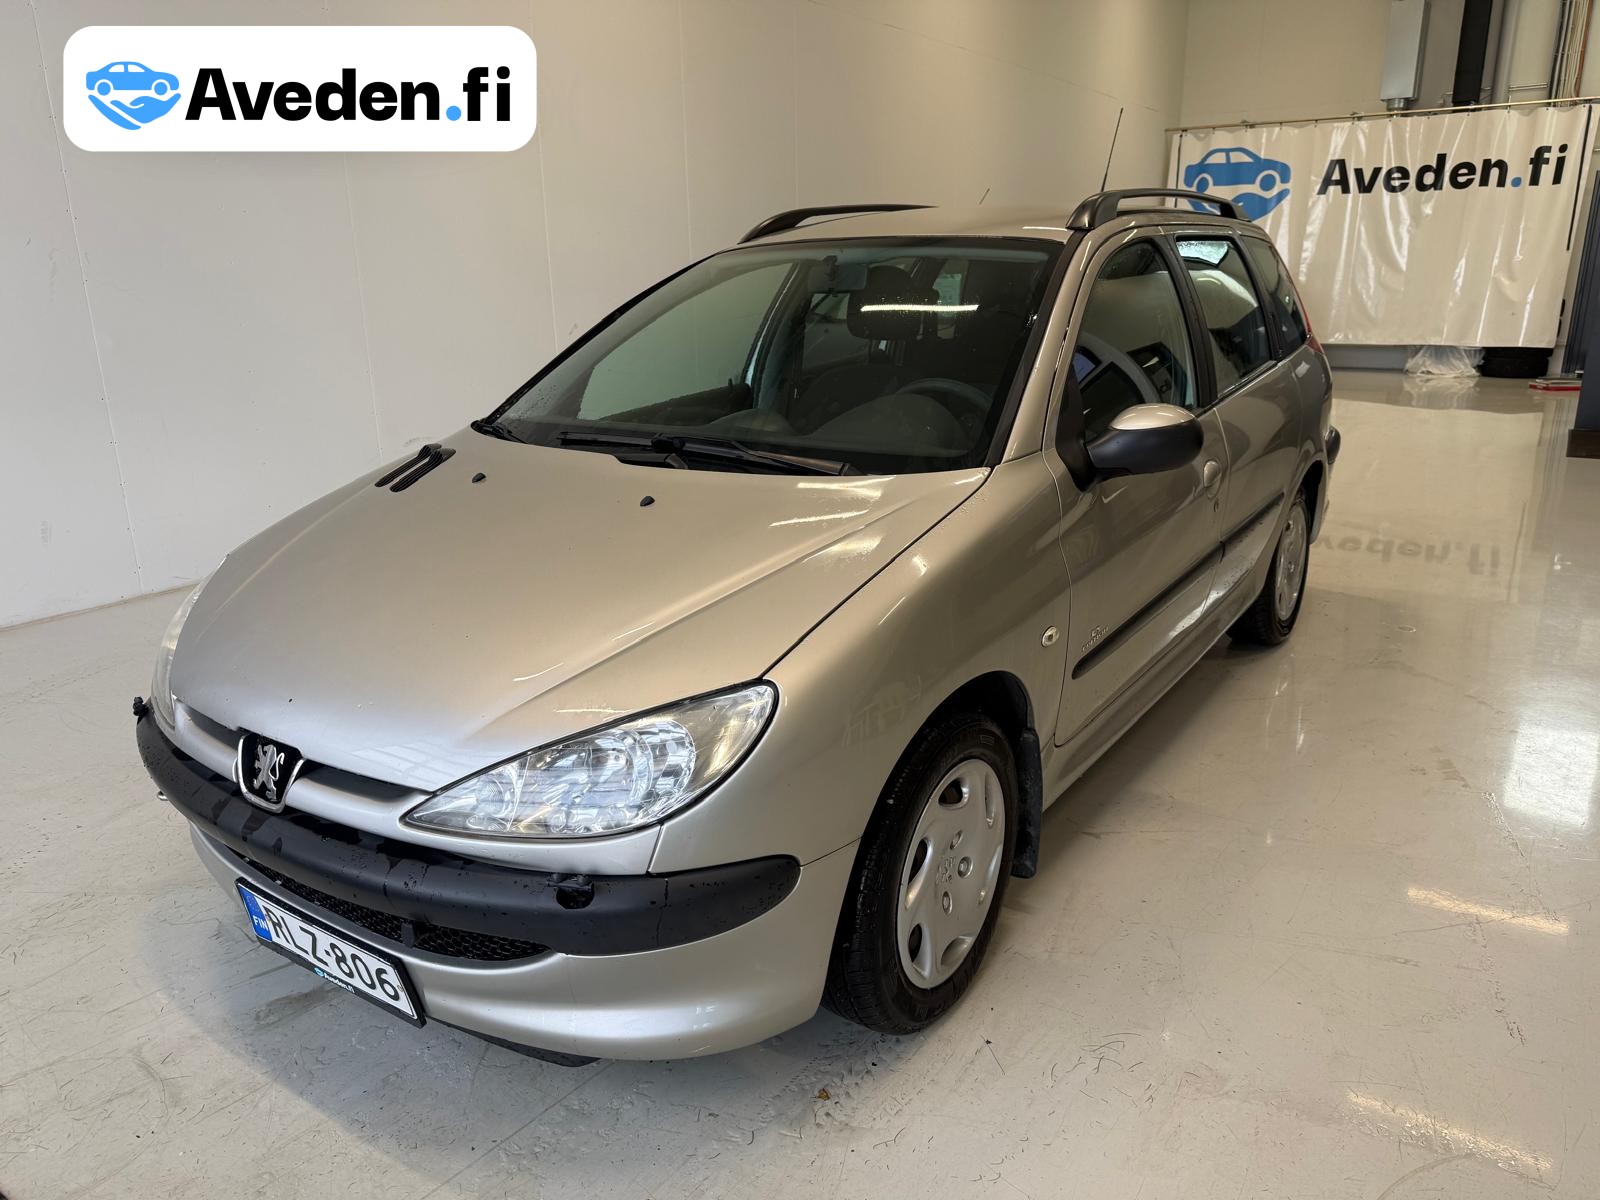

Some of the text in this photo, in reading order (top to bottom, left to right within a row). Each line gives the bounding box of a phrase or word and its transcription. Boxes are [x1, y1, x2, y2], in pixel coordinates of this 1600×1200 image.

[1317, 143, 1568, 195] Aveden.fi
[253, 915, 269, 931] FIN
[262, 904, 400, 1001] RLZ-806
